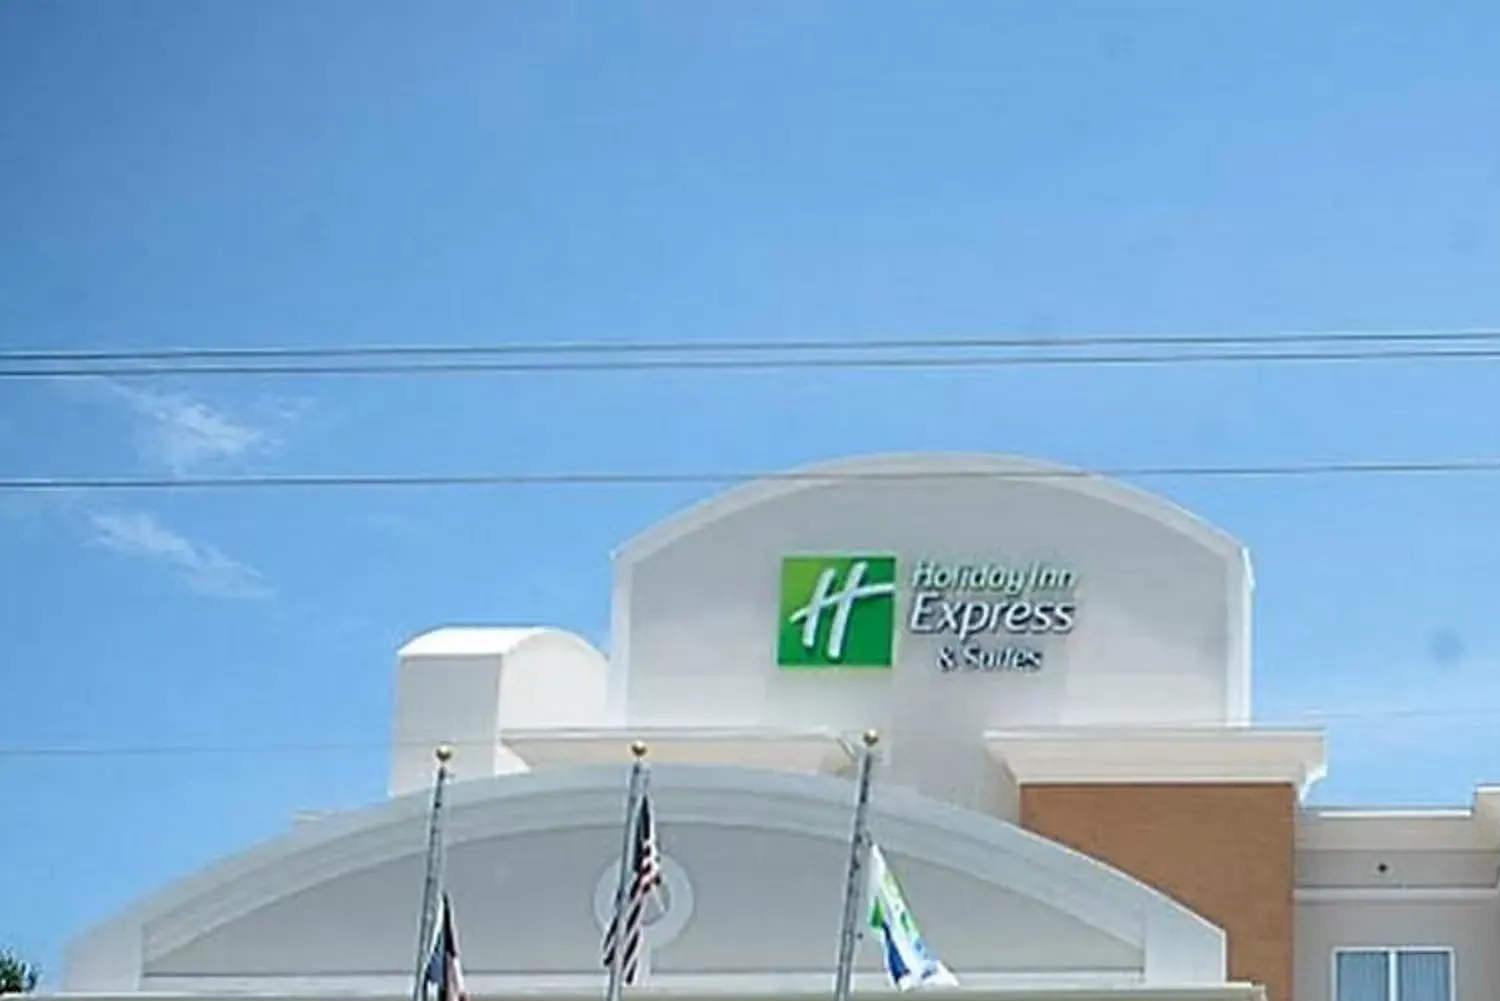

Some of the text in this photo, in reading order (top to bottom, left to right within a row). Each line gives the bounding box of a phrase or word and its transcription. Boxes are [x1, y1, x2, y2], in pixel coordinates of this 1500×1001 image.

[912, 559, 1077, 596] Holiday Inn
[910, 592, 1075, 641] Express
[936, 643, 1043, 672] & Suites
